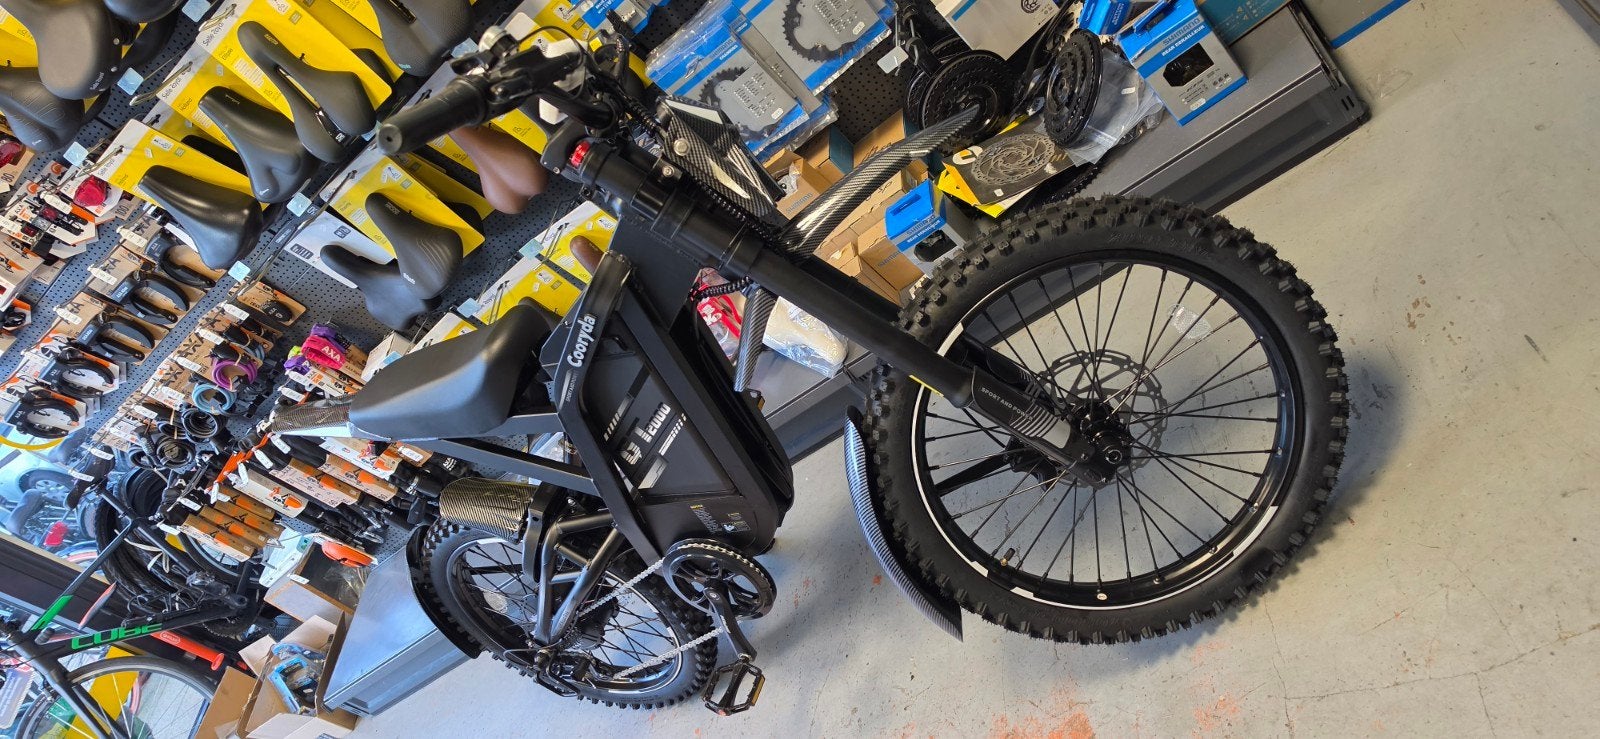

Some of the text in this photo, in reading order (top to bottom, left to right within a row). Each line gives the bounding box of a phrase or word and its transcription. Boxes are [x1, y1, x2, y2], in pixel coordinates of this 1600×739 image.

[1161, 16, 1200, 46] SHIMANO
[1160, 44, 1175, 57] REAR
[321, 345, 342, 363] AXA
[566, 313, 596, 369] Cooryda
[980, 387, 1034, 422] SPORT AND POWER
